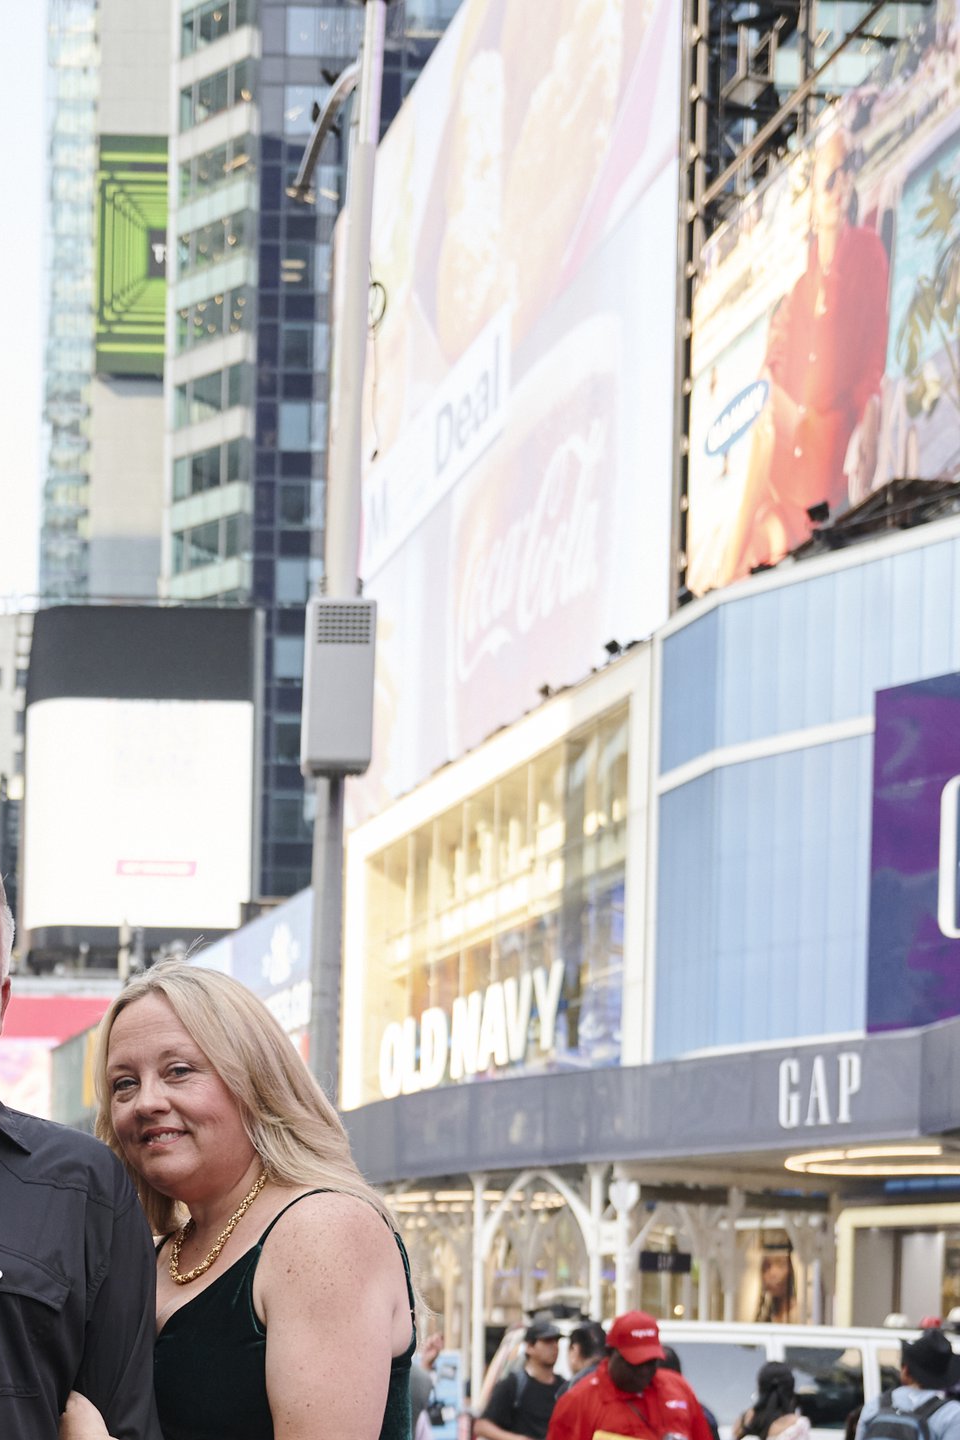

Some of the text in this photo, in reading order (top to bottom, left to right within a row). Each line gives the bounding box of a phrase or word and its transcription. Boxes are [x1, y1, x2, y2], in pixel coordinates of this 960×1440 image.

[434, 335, 501, 478] Deal
[379, 957, 565, 1099] OLD NAVY
[778, 1051, 861, 1130] GAP
